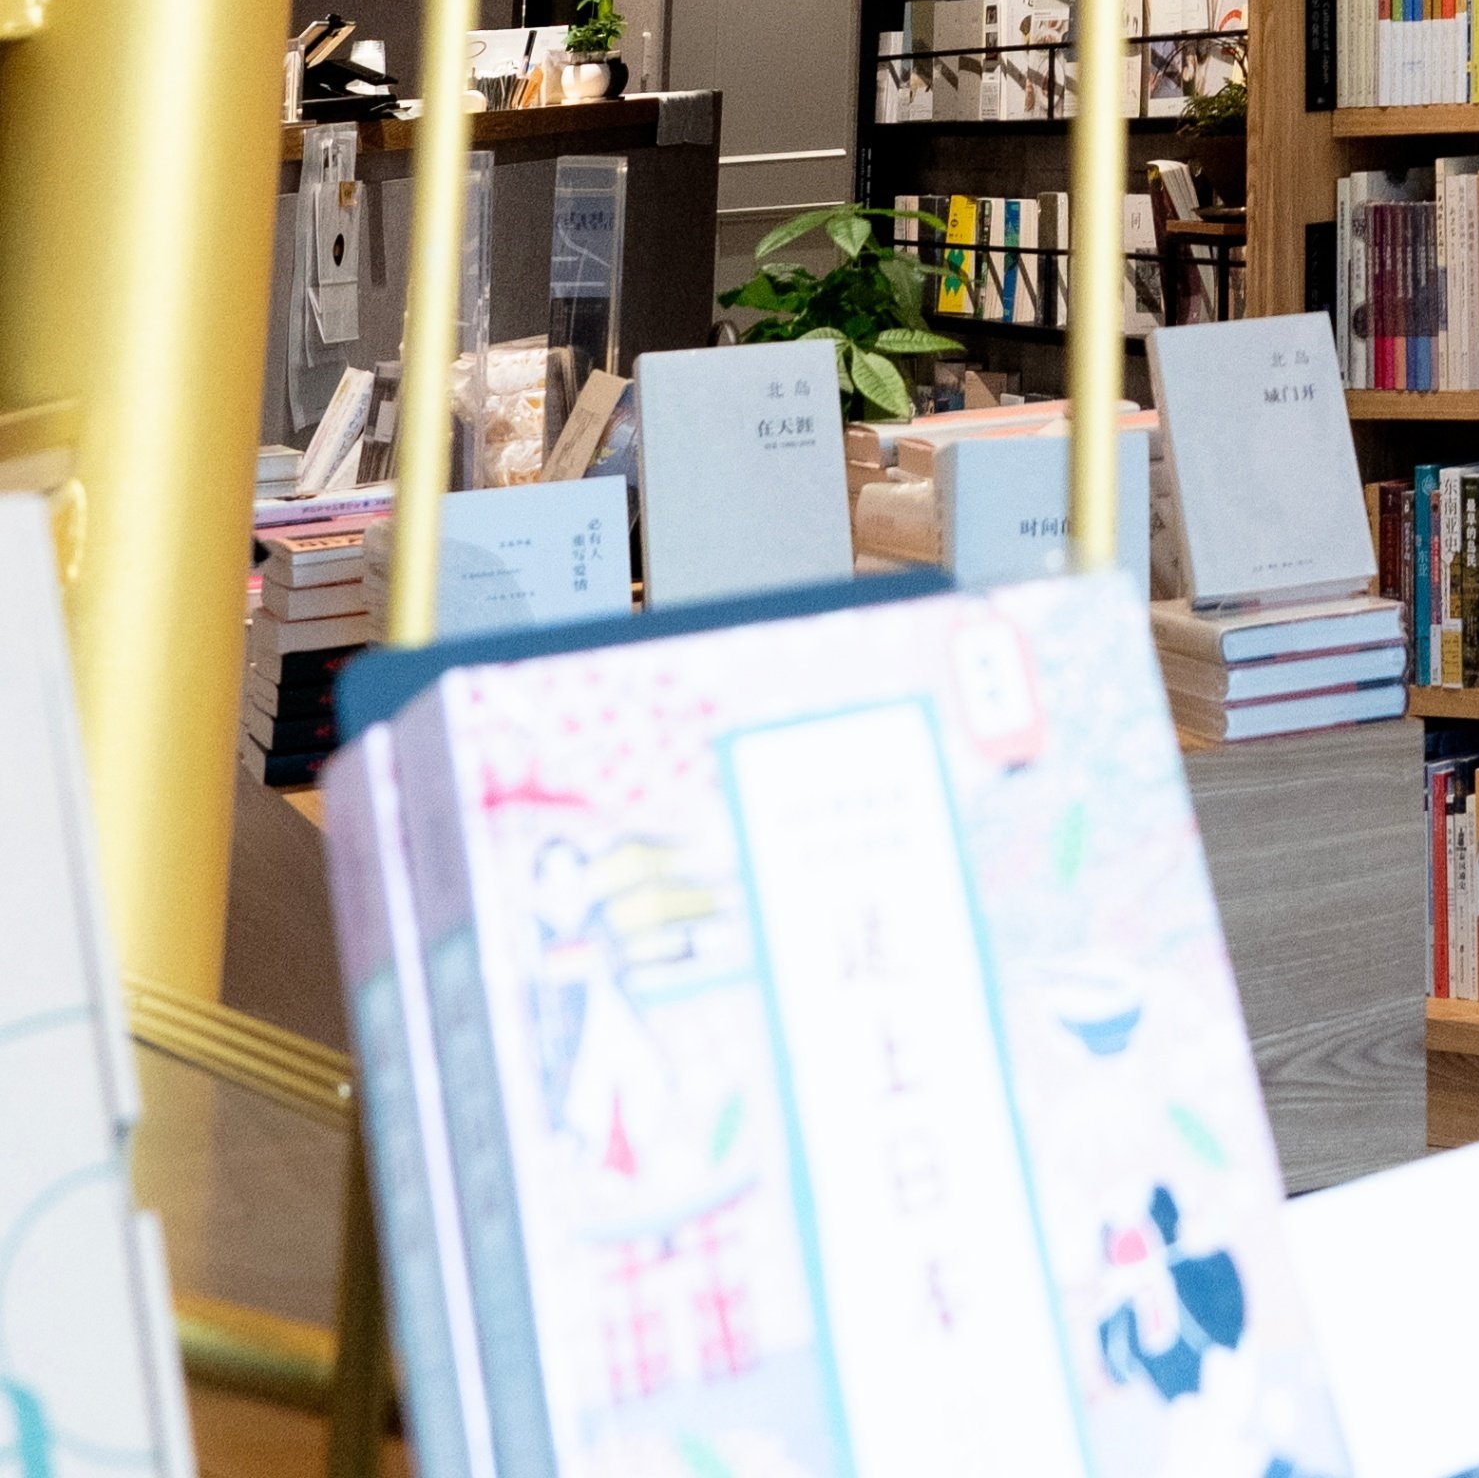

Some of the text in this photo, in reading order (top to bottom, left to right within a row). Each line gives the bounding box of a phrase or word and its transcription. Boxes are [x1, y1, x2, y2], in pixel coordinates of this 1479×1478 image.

[1263, 381, 1316, 404] 城门开
[758, 415, 814, 438] 在天涯
[1444, 477, 1458, 553] 东南亚史
